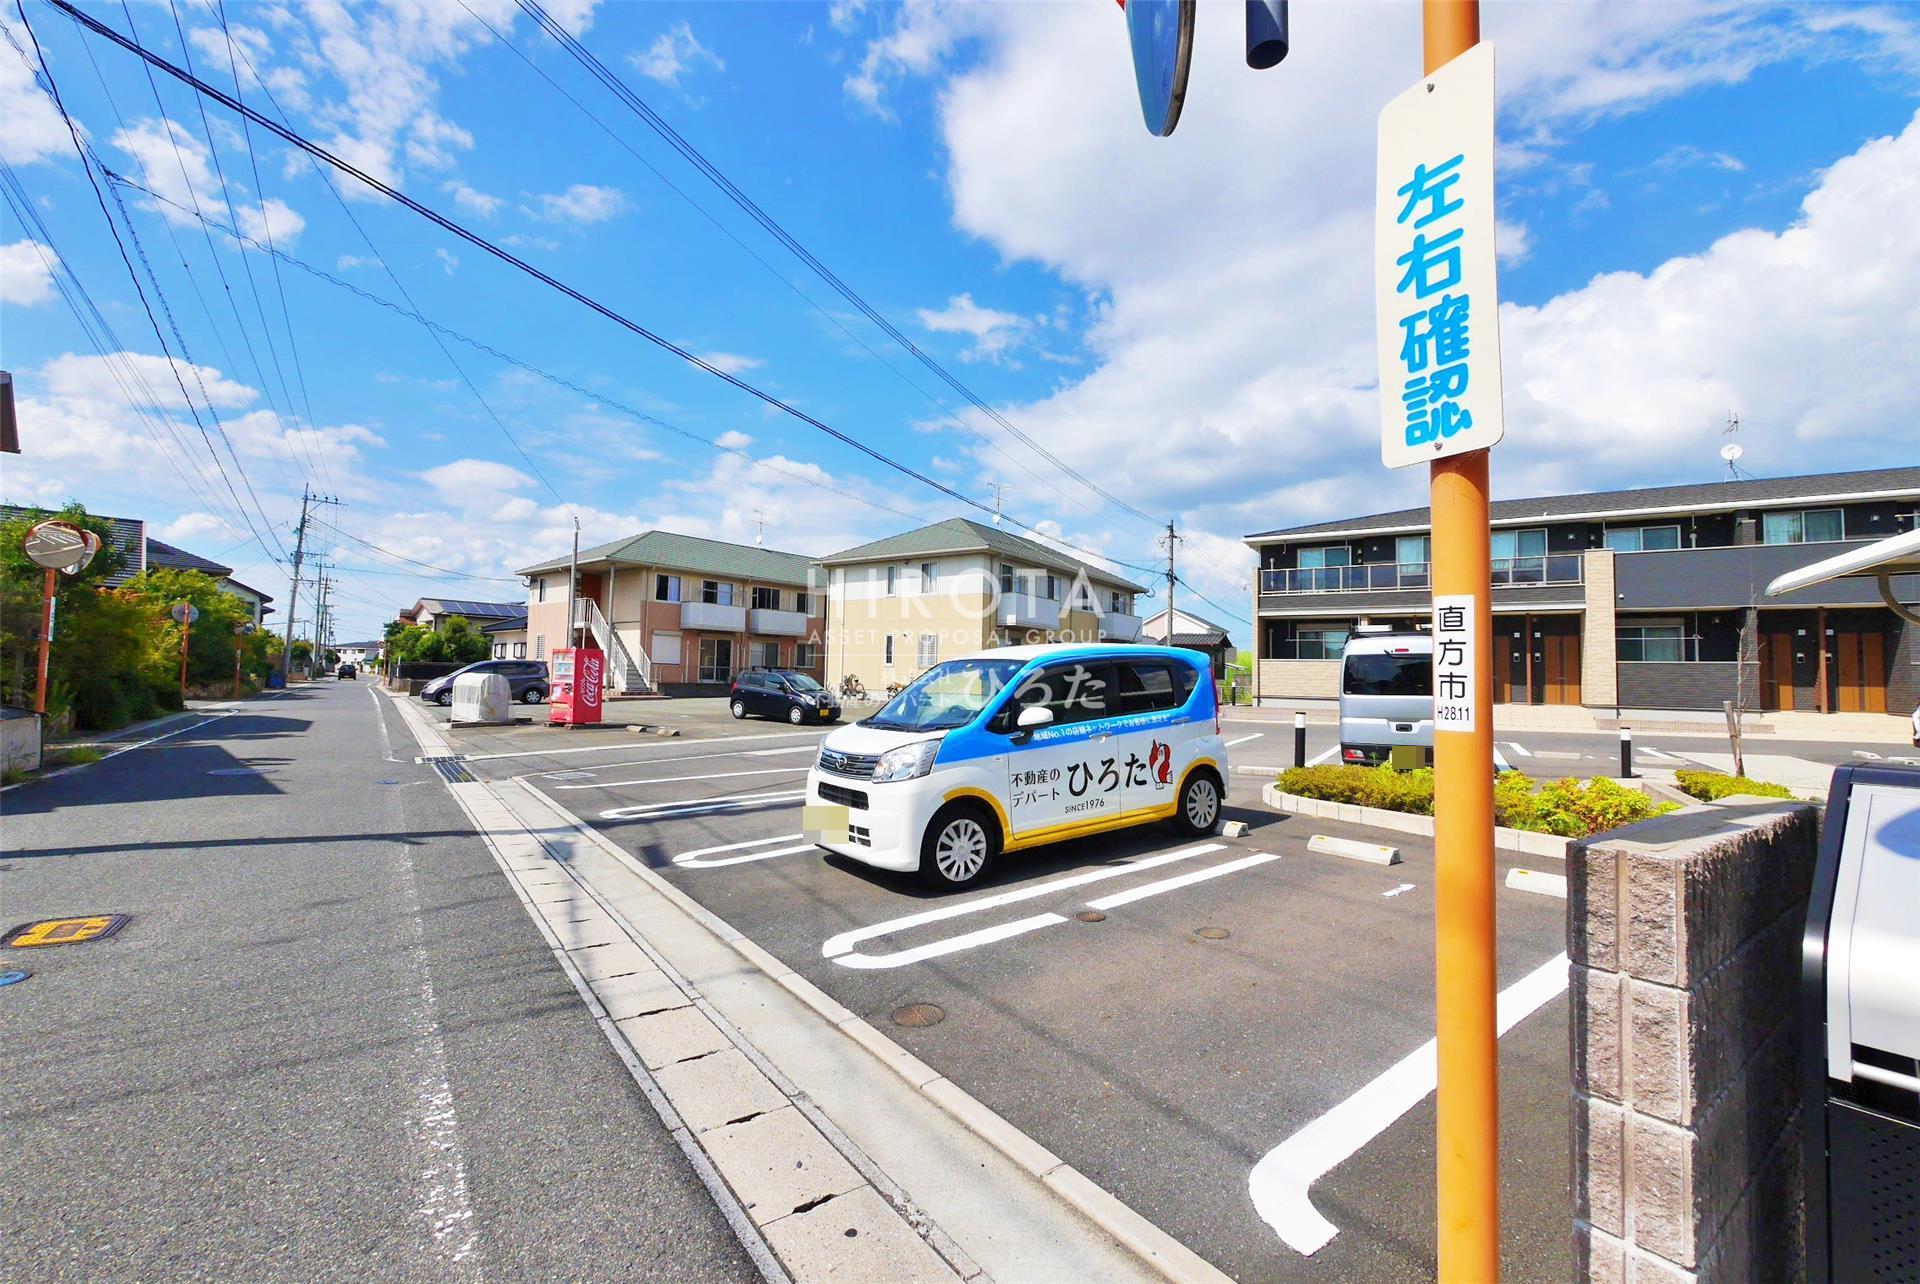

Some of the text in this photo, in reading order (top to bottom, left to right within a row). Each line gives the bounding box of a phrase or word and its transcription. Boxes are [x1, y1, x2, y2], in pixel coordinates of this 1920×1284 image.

[1396, 154, 1472, 446] 左右確認
[1438, 605, 1468, 700] 直方市
[1437, 703, 1471, 721] H28.11
[1011, 768, 1061, 788] 不動産の
[1067, 753, 1148, 797] ひろた
[1012, 788, 1060, 808] デパート
